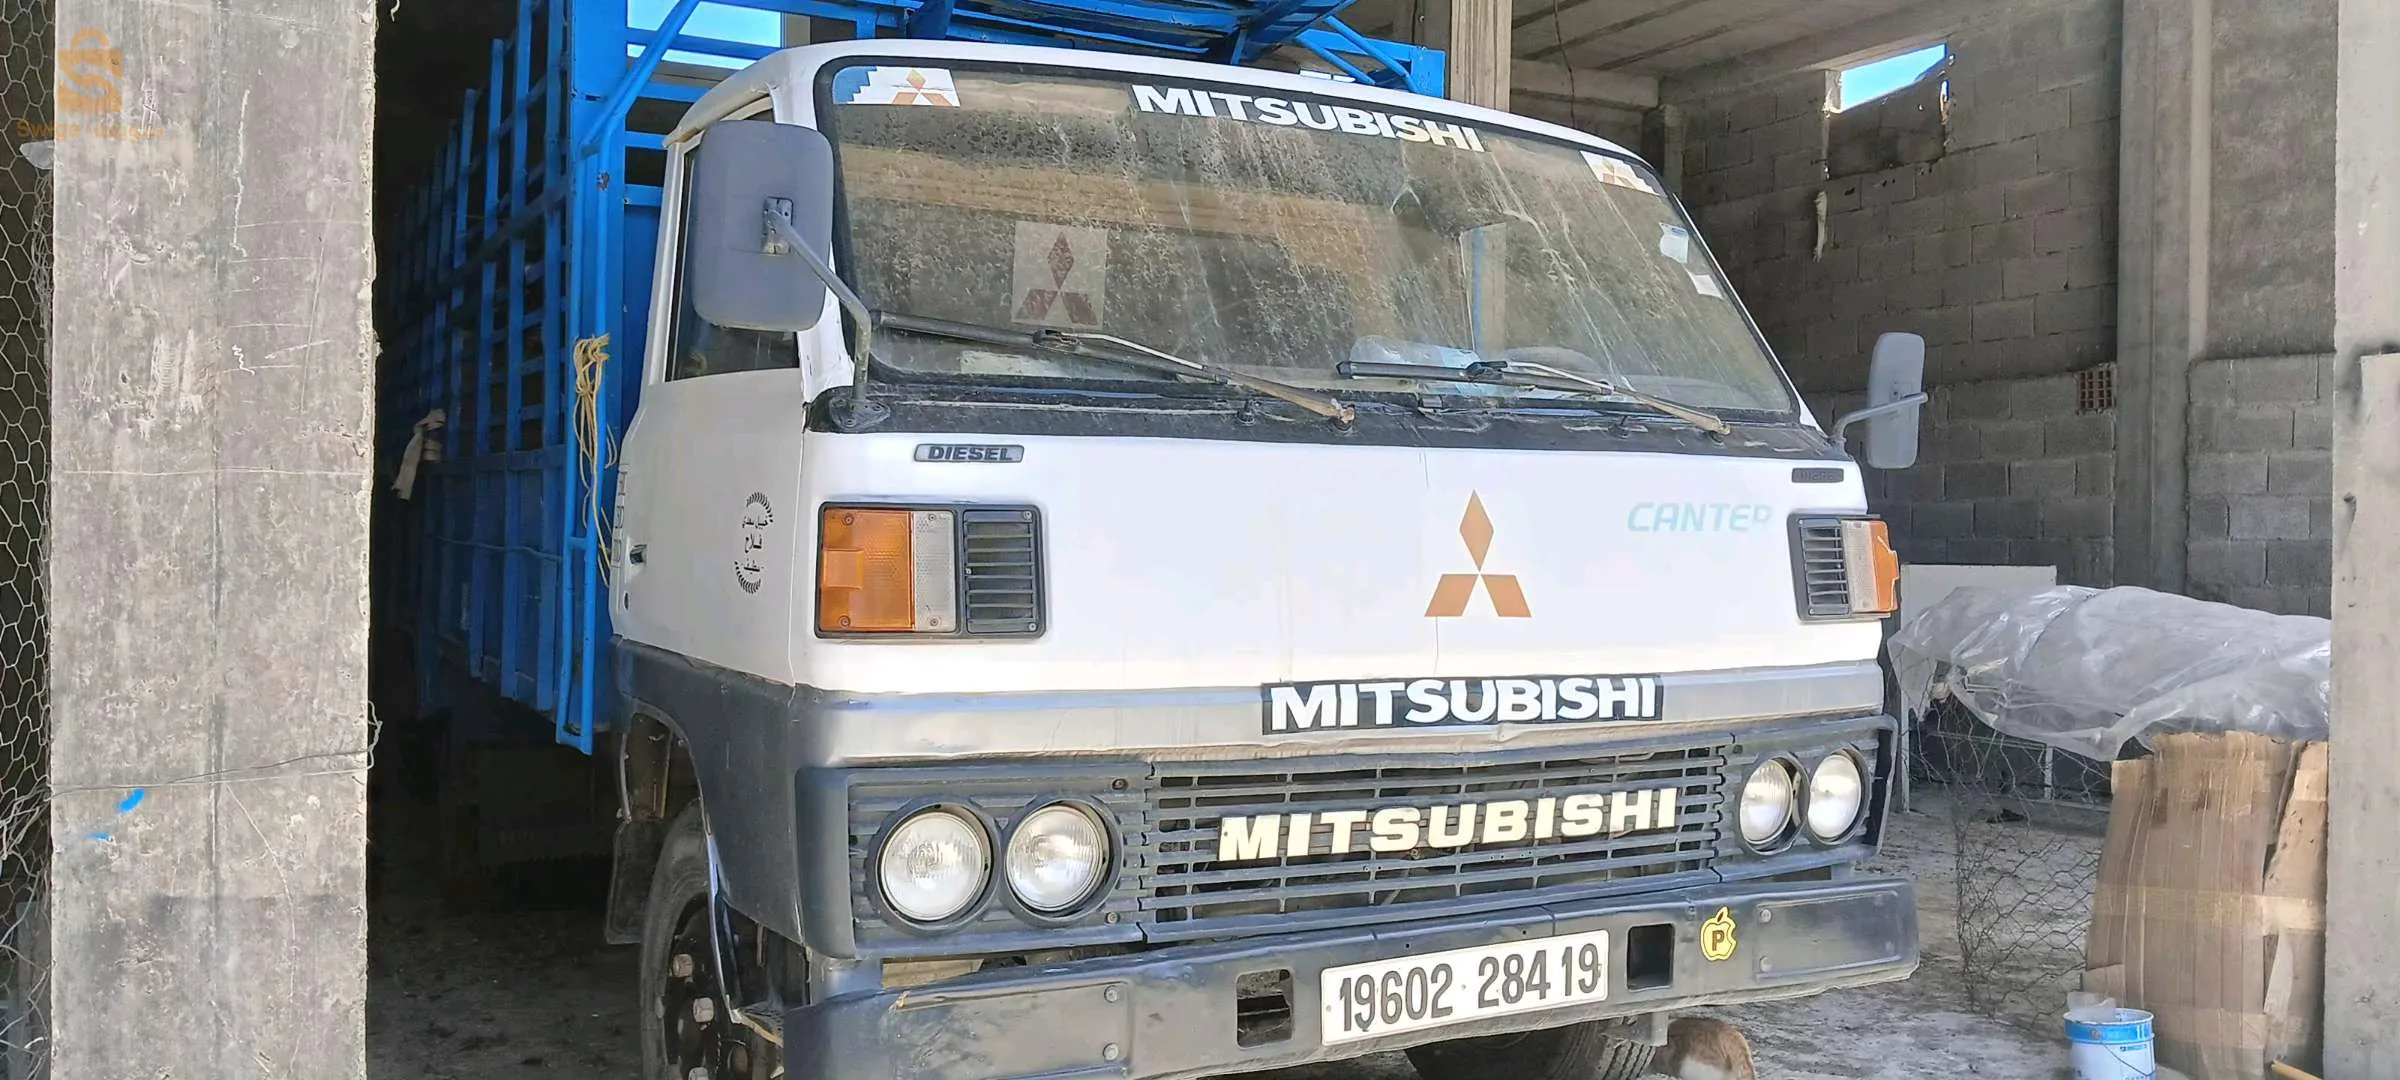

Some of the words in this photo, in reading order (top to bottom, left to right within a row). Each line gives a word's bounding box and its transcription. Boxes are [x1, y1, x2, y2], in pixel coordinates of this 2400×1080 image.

[1131, 84, 1486, 153] MITSUBISHI
[927, 446, 1013, 461] DIESEL
[1270, 677, 1657, 731] MITSUBISHI
[1218, 787, 1678, 862] MITSUBISHI
[1711, 930, 1725, 952] P
[1339, 963, 1453, 1032] 19602
[1477, 949, 1551, 1009] 284
[1561, 943, 1600, 997] 19
